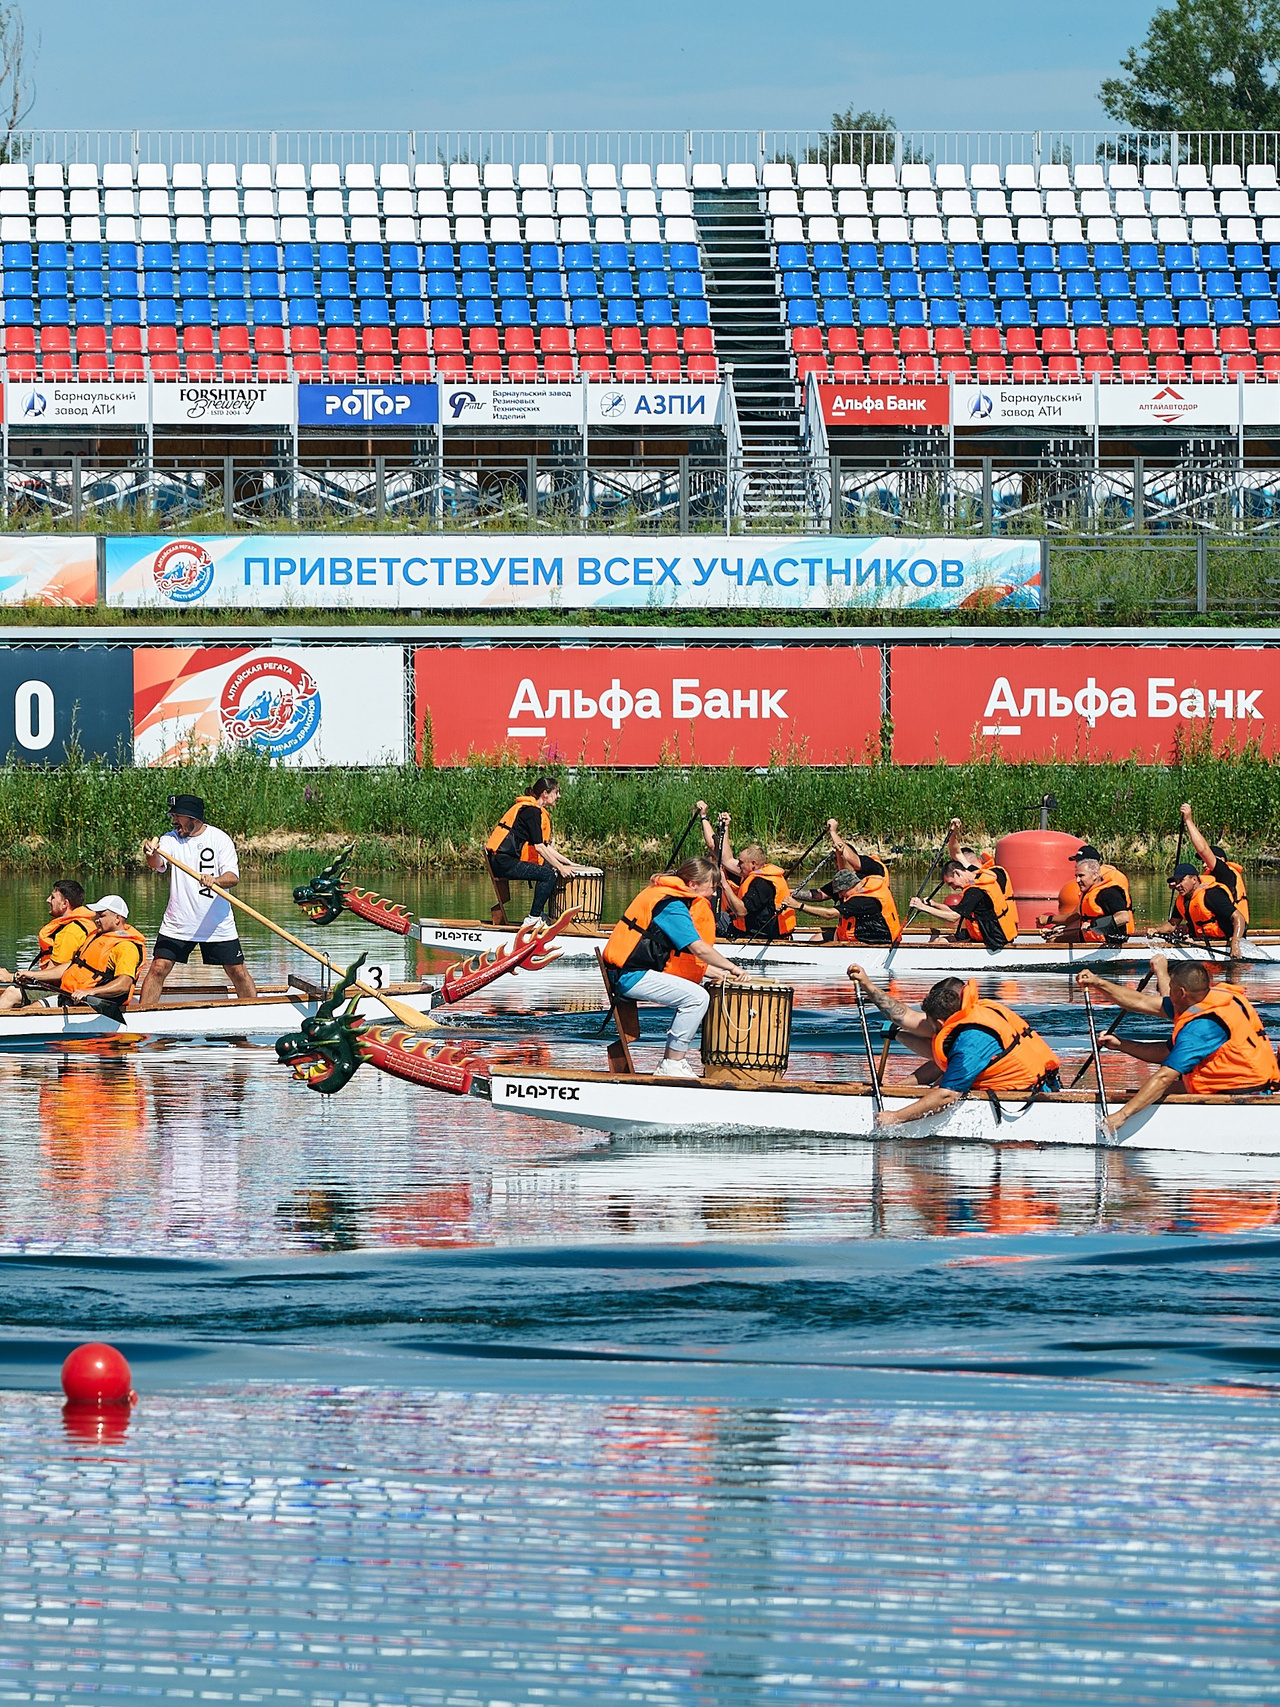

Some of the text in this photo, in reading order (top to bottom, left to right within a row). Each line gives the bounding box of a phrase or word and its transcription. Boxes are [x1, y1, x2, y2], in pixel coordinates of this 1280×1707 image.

[54, 390, 136, 402] Барнаульский
[180, 388, 267, 401] FORSHTADT
[492, 390, 547, 398] Барнаульский
[1000, 392, 1082, 405] Барнаульский
[54, 405, 116, 417] завод АТИ
[186, 399, 256, 418] Brewery
[326, 388, 411, 420] РОТОР
[634, 395, 705, 415] АЗПИ
[832, 396, 926, 413] Альфа Банк
[1001, 407, 1062, 418] завод АТИ
[1138, 403, 1198, 411] АЛТАЙАВТОДОР
[244, 557, 964, 587] ПРИВЕТСТВУЕМ ВСЕХ УЧАСТНИКОВ
[228, 663, 292, 701] АЛТАЙСКАЯ РЕГАТА
[508, 678, 788, 729] Альфа Банк
[983, 677, 1265, 728] Альфа Банк
[15, 679, 55, 750] 0
[297, 700, 315, 741] ДРАКОНОВ
[435, 931, 482, 942] PLASTEX
[367, 966, 383, 989] 3
[506, 1084, 580, 1100] PLASTEX
